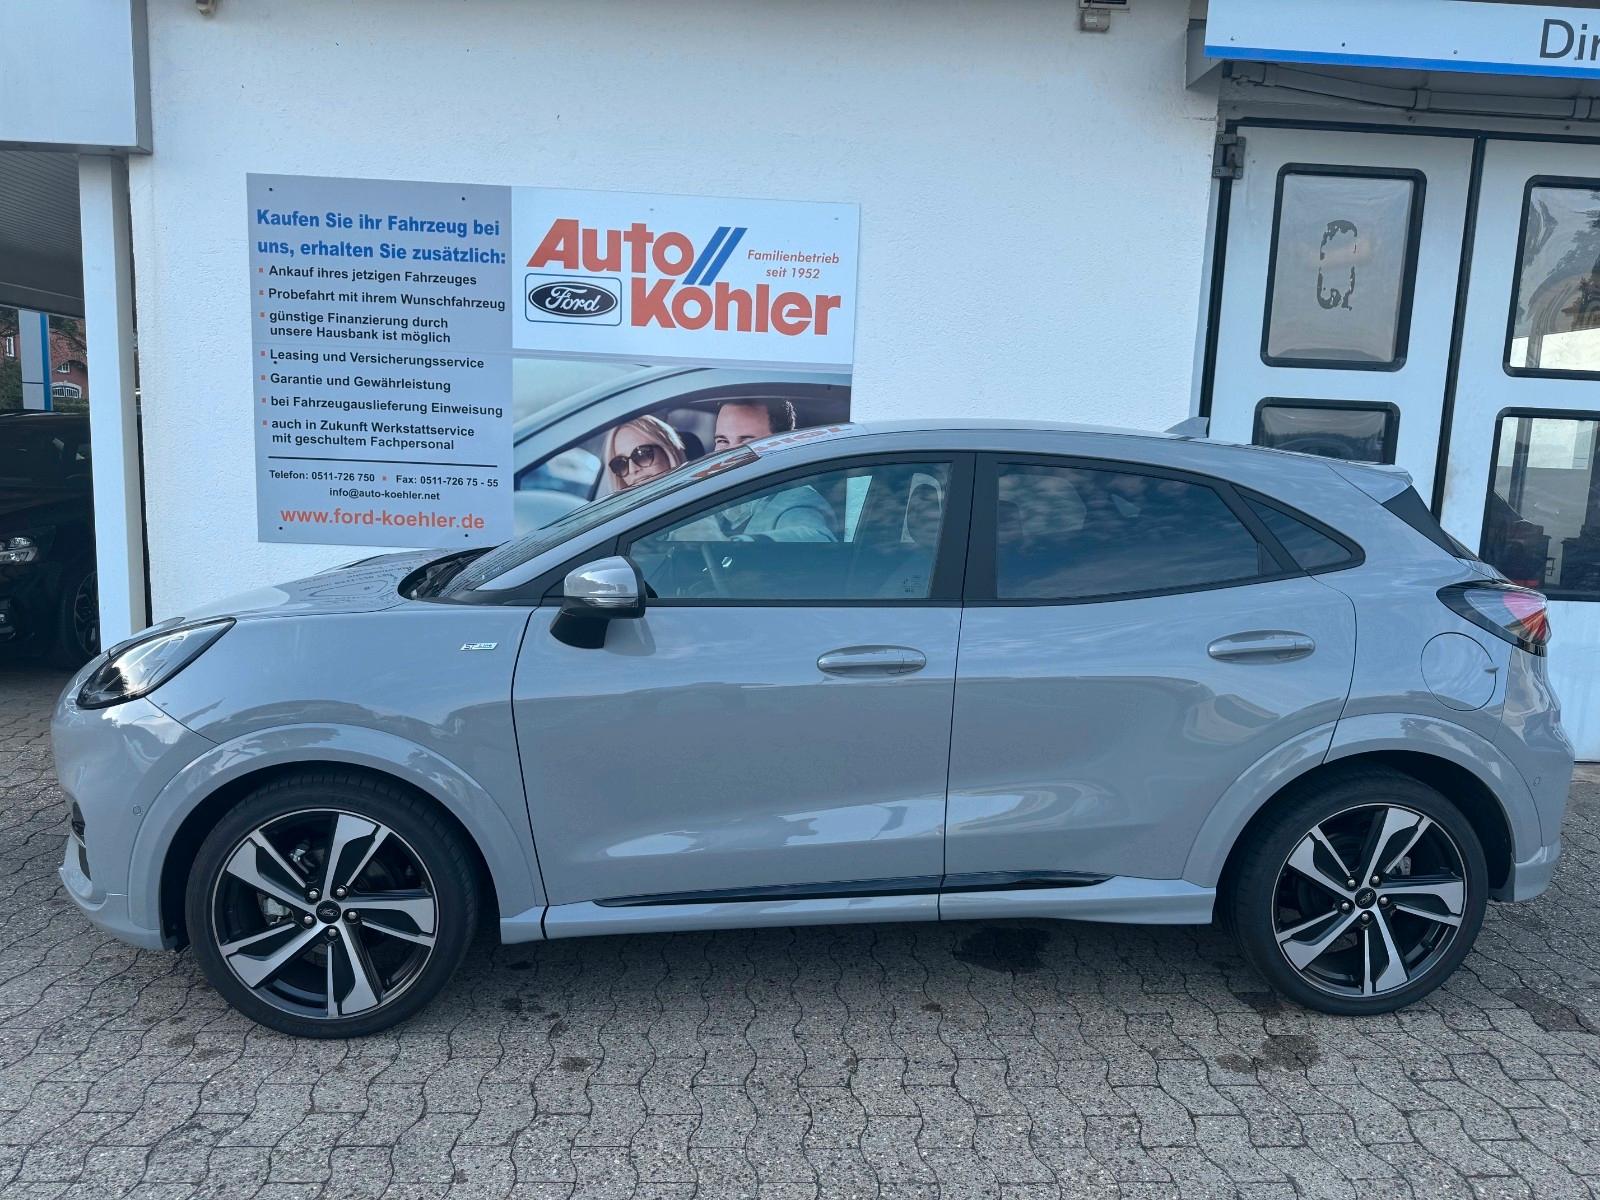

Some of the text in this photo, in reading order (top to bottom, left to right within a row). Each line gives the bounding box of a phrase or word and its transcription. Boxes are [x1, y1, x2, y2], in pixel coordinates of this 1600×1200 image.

[256, 209, 500, 238] Kaufen Sie ihr Fahrzeug bei
[258, 240, 506, 264] uns, erhalten Sie zusätzlich:
[527, 218, 695, 276] Auto
[747, 249, 840, 264] Familienbetrieb
[269, 266, 477, 285] Ankauf ihres jetzigen Fahrzeuges
[766, 267, 820, 279] seit 1952
[269, 288, 505, 311] Probefahrt mit ihrem Wunschfahrzeug
[545, 286, 601, 312] Ford
[270, 310, 448, 328] günstige Finanzierung durch
[270, 327, 451, 344] unsere Hausbank ist möglich
[270, 349, 484, 369] Leasing und Versicherungsservice
[271, 373, 451, 393] Garantie und Gewährleistung
[271, 396, 503, 417] bei Fahrzeugauslieferung Einweisung
[272, 419, 475, 437] auch in Zukunft Werkstattservice
[272, 434, 454, 451] mit geschultem Fachpersonal
[269, 470, 309, 481] Telefon:
[312, 471, 355, 482] 0511-726
[358, 473, 375, 483] 750
[396, 475, 417, 484] Fax:
[420, 476, 463, 486] 0511-726
[467, 477, 478, 487] 75
[487, 478, 499, 488] 55
[330, 488, 440, 501] info@auto-koehler.net
[280, 508, 484, 529] www.ford-koehler.de
